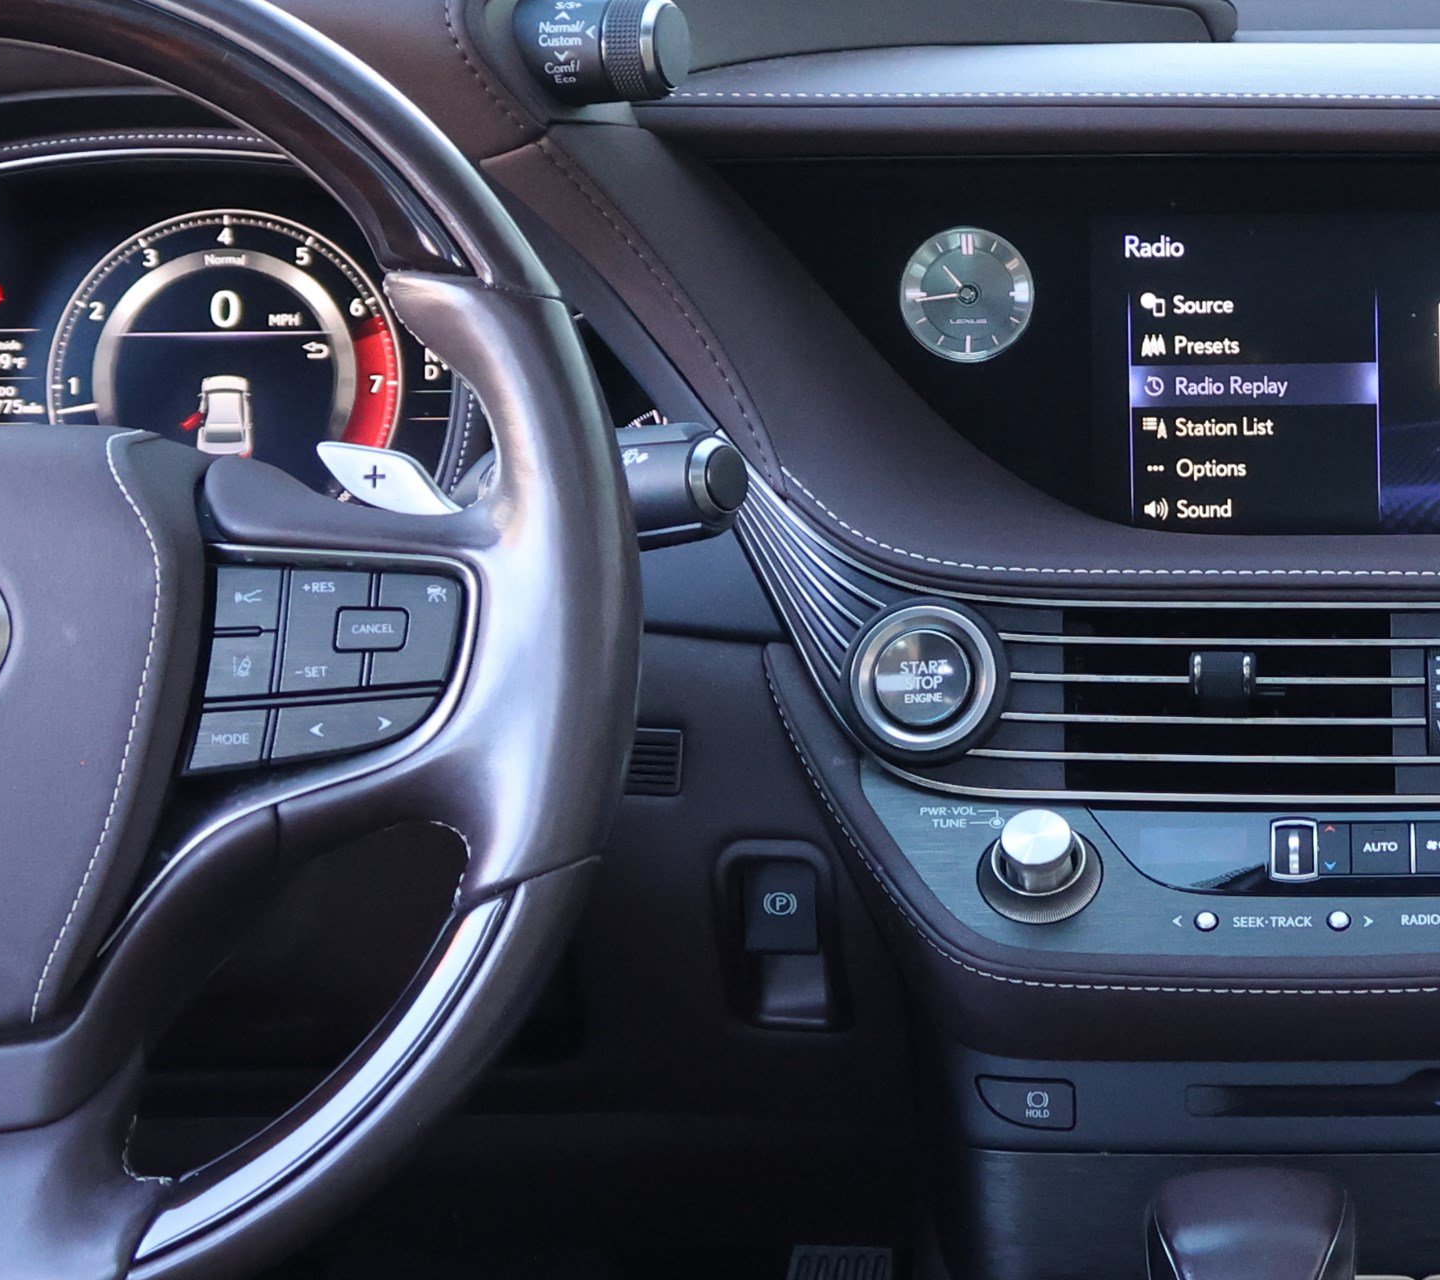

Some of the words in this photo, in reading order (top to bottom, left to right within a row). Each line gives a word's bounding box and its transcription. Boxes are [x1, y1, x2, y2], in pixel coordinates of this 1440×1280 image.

[539, 20, 585, 34] Normal/
[538, 35, 582, 46] Custom
[544, 61, 580, 75] Comf/
[555, 75, 577, 84] Eco
[217, 227, 233, 245] 4
[1124, 235, 1185, 258] Radio
[142, 248, 158, 267] 3
[204, 254, 245, 266] Normal
[295, 247, 310, 266] 5
[88, 302, 105, 320] 2
[209, 290, 242, 328] 0
[349, 298, 364, 317] 6
[1173, 295, 1234, 314] Source
[268, 313, 301, 326] MPH
[1174, 335, 1240, 355] Presets
[424, 365, 439, 381] D
[67, 377, 80, 395] 1
[369, 375, 385, 394] 7
[1175, 376, 1225, 396] Radio
[1230, 376, 1288, 398] Replay
[1175, 417, 1238, 436] Station
[1242, 417, 1274, 436] List
[1176, 458, 1246, 481] Options
[1176, 499, 1232, 518] Sound
[351, 623, 395, 634] CANCEL
[900, 659, 948, 674] START
[905, 676, 943, 690] STOP
[904, 693, 943, 704] ENGINE
[211, 733, 250, 745] MODE
[932, 819, 967, 828] TUNE
[1363, 841, 1398, 853] AUTO
[1401, 914, 1440, 925] RADIO
[1025, 1109, 1050, 1118] HOLD
